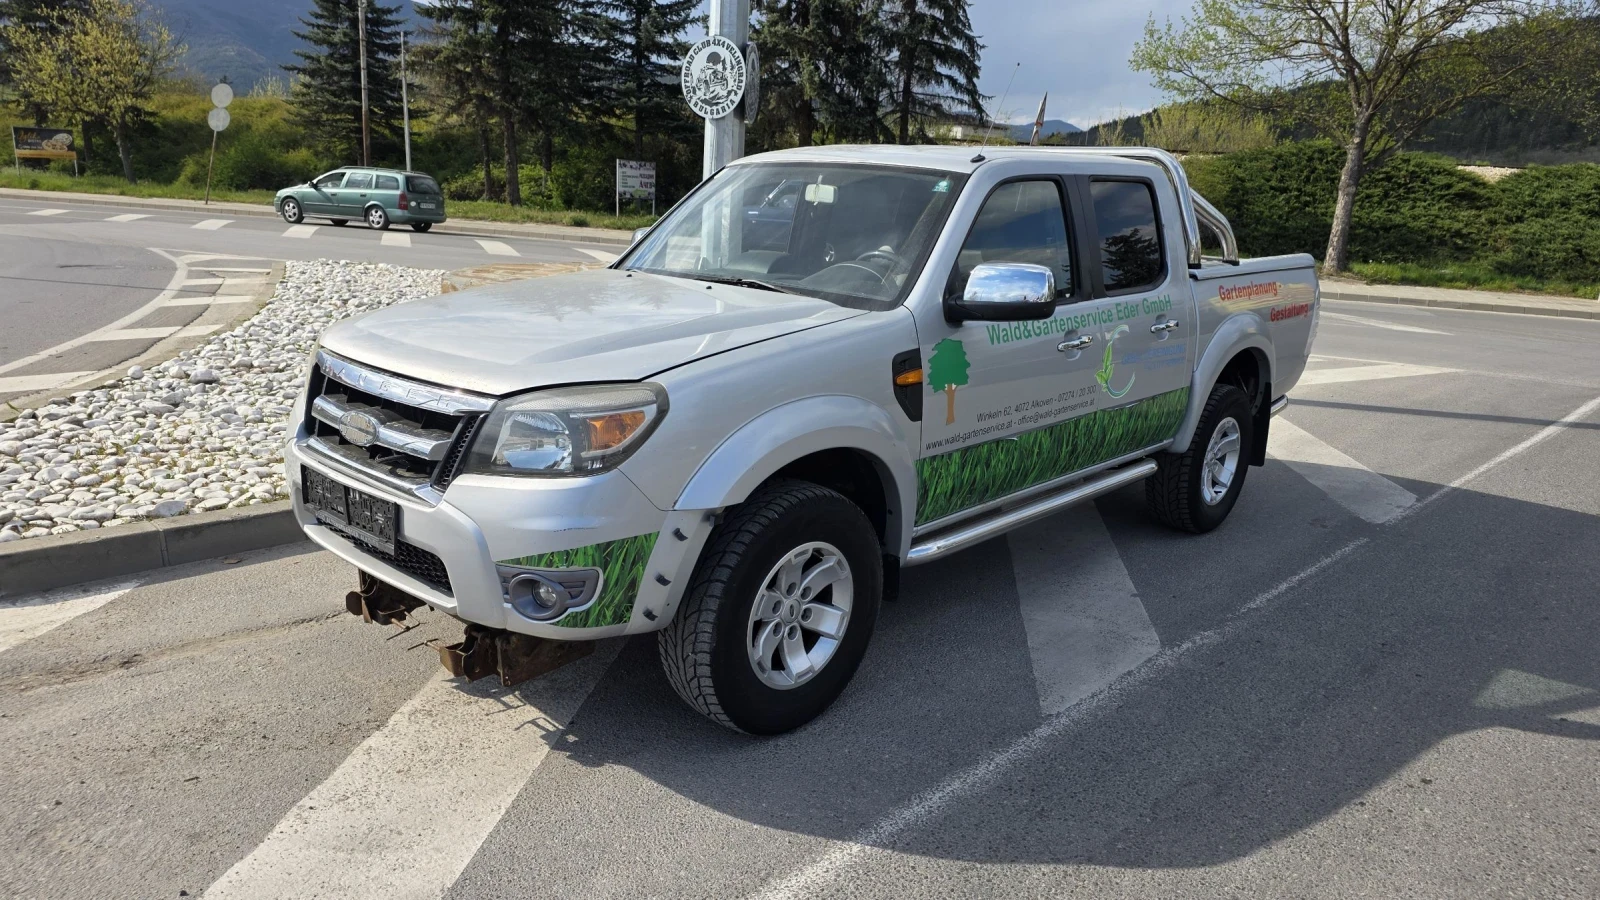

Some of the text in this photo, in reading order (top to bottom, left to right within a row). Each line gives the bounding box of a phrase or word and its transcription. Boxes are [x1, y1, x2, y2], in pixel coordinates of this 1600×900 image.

[683, 53, 695, 96] OFFROAD
[693, 39, 711, 55] CLUB
[725, 43, 744, 91] VELINGRAD
[693, 98, 736, 116] BULGARIA
[1218, 280, 1278, 301] Gartenplanung
[986, 294, 1172, 346] Wald&Gartenservice Eder GmbH
[1270, 303, 1309, 322] Gestaltung
[976, 409, 1002, 423] Winkeln
[1014, 401, 1030, 412] 4072
[1030, 397, 1053, 409] Alkoven
[1057, 390, 1075, 402] 07274
[925, 420, 1013, 450] www.wald-gartenservice.at
[1017, 397, 1095, 426] office@wald-gartenservice.at
